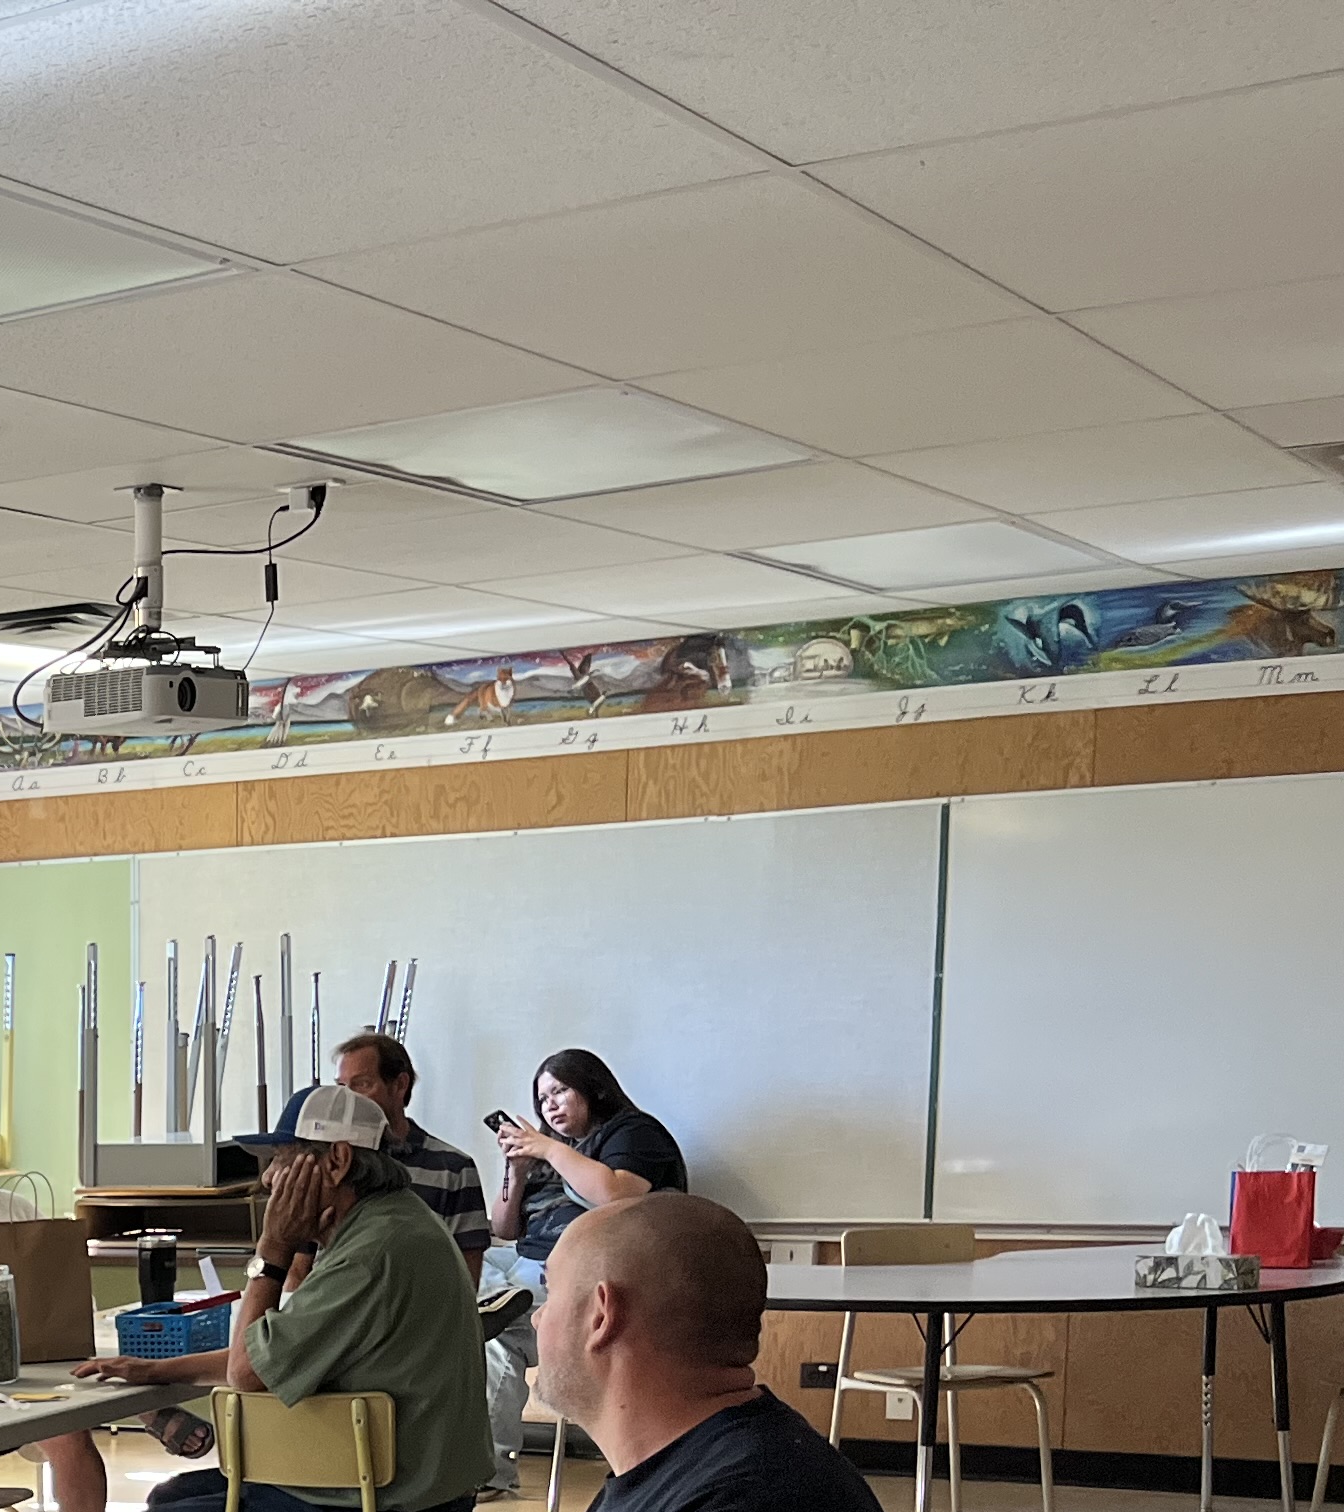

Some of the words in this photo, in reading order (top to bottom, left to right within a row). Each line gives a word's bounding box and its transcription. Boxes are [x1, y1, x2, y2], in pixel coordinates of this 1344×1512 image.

[97, 768, 109, 784] B
[114, 767, 127, 783] b
[183, 760, 195, 777] C
[271, 752, 292, 769] D
[294, 750, 308, 768] d
[374, 744, 385, 761] E
[459, 735, 481, 754] F
[481, 734, 493, 760] f
[585, 732, 599, 750] g
[670, 716, 688, 736] H
[693, 714, 710, 734] h
[1017, 685, 1037, 705] K
[1138, 674, 1160, 695] L
[1163, 672, 1179, 693] l
[1259, 664, 1285, 685] M
[1288, 671, 1320, 684] m
